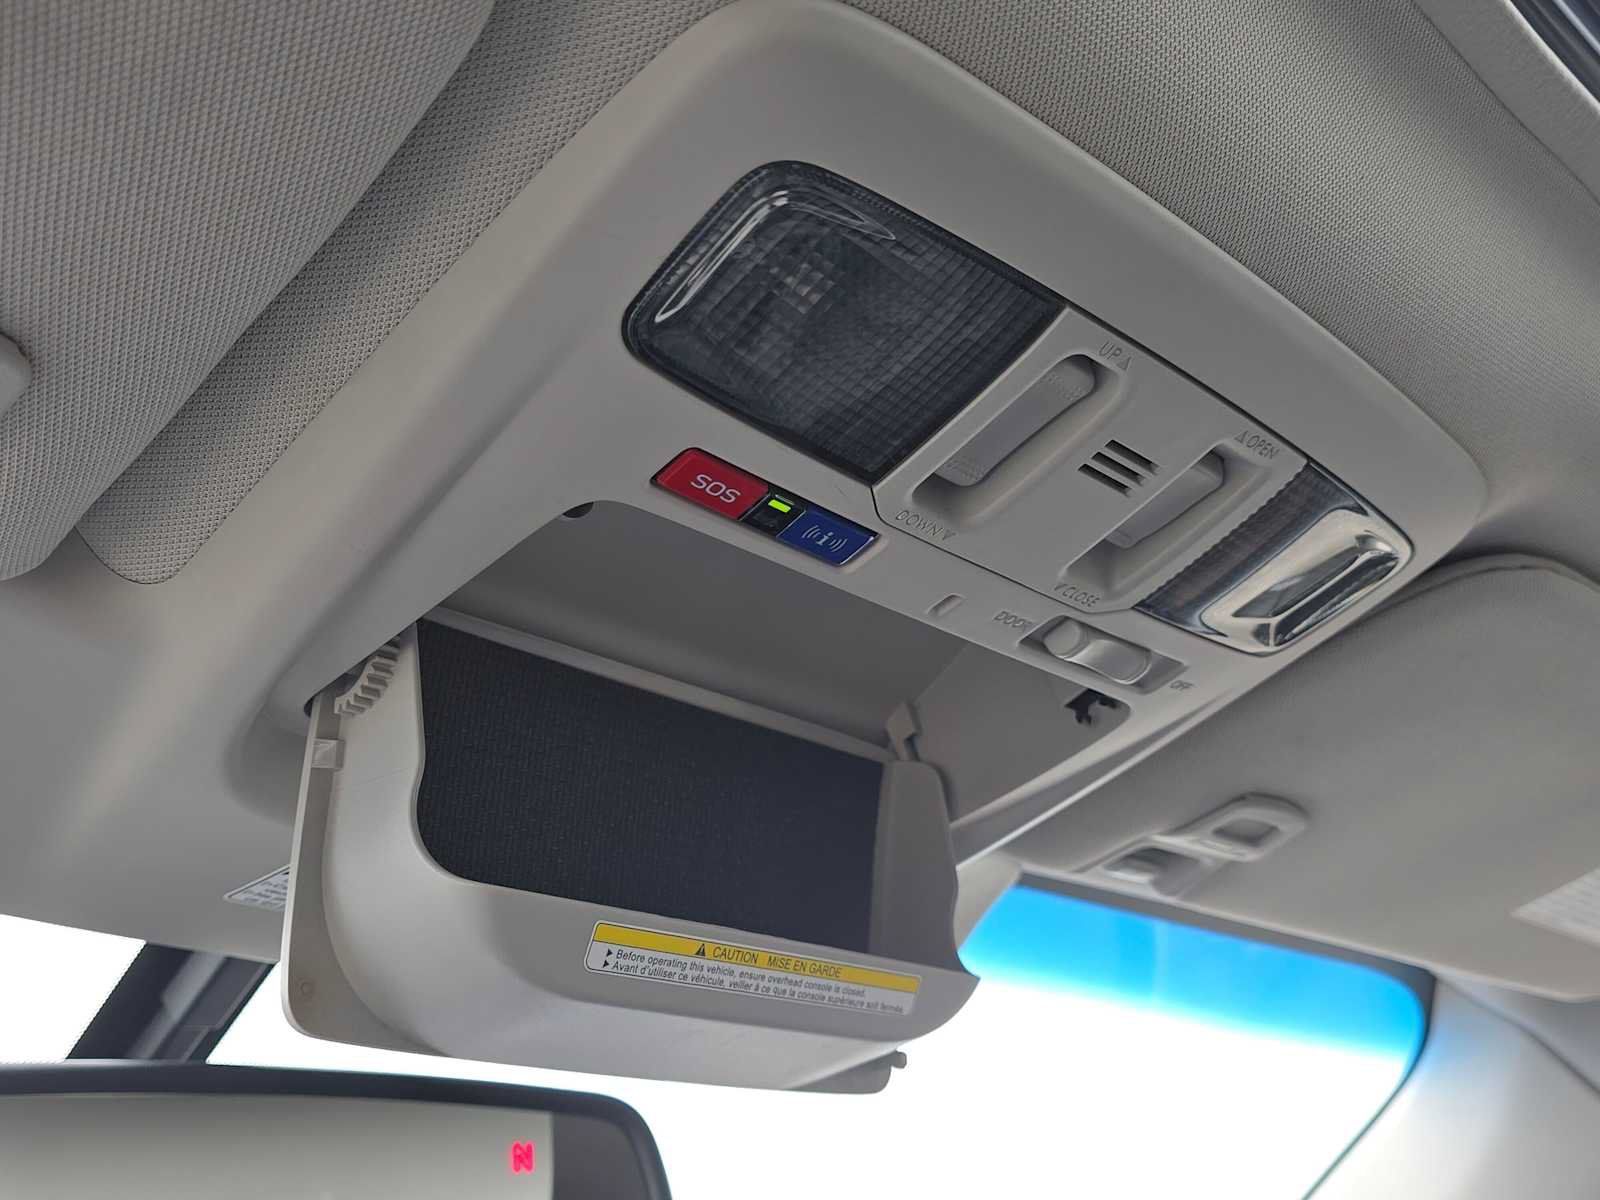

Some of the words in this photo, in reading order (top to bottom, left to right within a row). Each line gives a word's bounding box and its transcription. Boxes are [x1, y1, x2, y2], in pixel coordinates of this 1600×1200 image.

[1098, 341, 1123, 361] UP
[1246, 434, 1281, 460] OPEN
[690, 474, 742, 504] SOS
[895, 510, 945, 537] DOWN
[1062, 586, 1101, 608] CLOSE
[1170, 679, 1195, 692] OFF
[616, 949, 646, 964] Before
[647, 956, 688, 972] operating
[689, 960, 704, 972] this
[738, 970, 767, 981] ensure
[767, 975, 803, 988] overhead
[804, 980, 833, 993] console
[712, 946, 759, 964] CAUTION
[767, 955, 791, 970] MISE
[793, 960, 806, 972] EN
[808, 963, 842, 978] GARDE
[612, 961, 638, 975] Avant
[677, 973, 689, 981] ce
[728, 979, 754, 992] veiller
[760, 984, 771, 994] ce
[772, 986, 787, 997] que
[789, 988, 798, 998] la
[797, 990, 826, 1002] console
[511, 1140, 535, 1175] N
